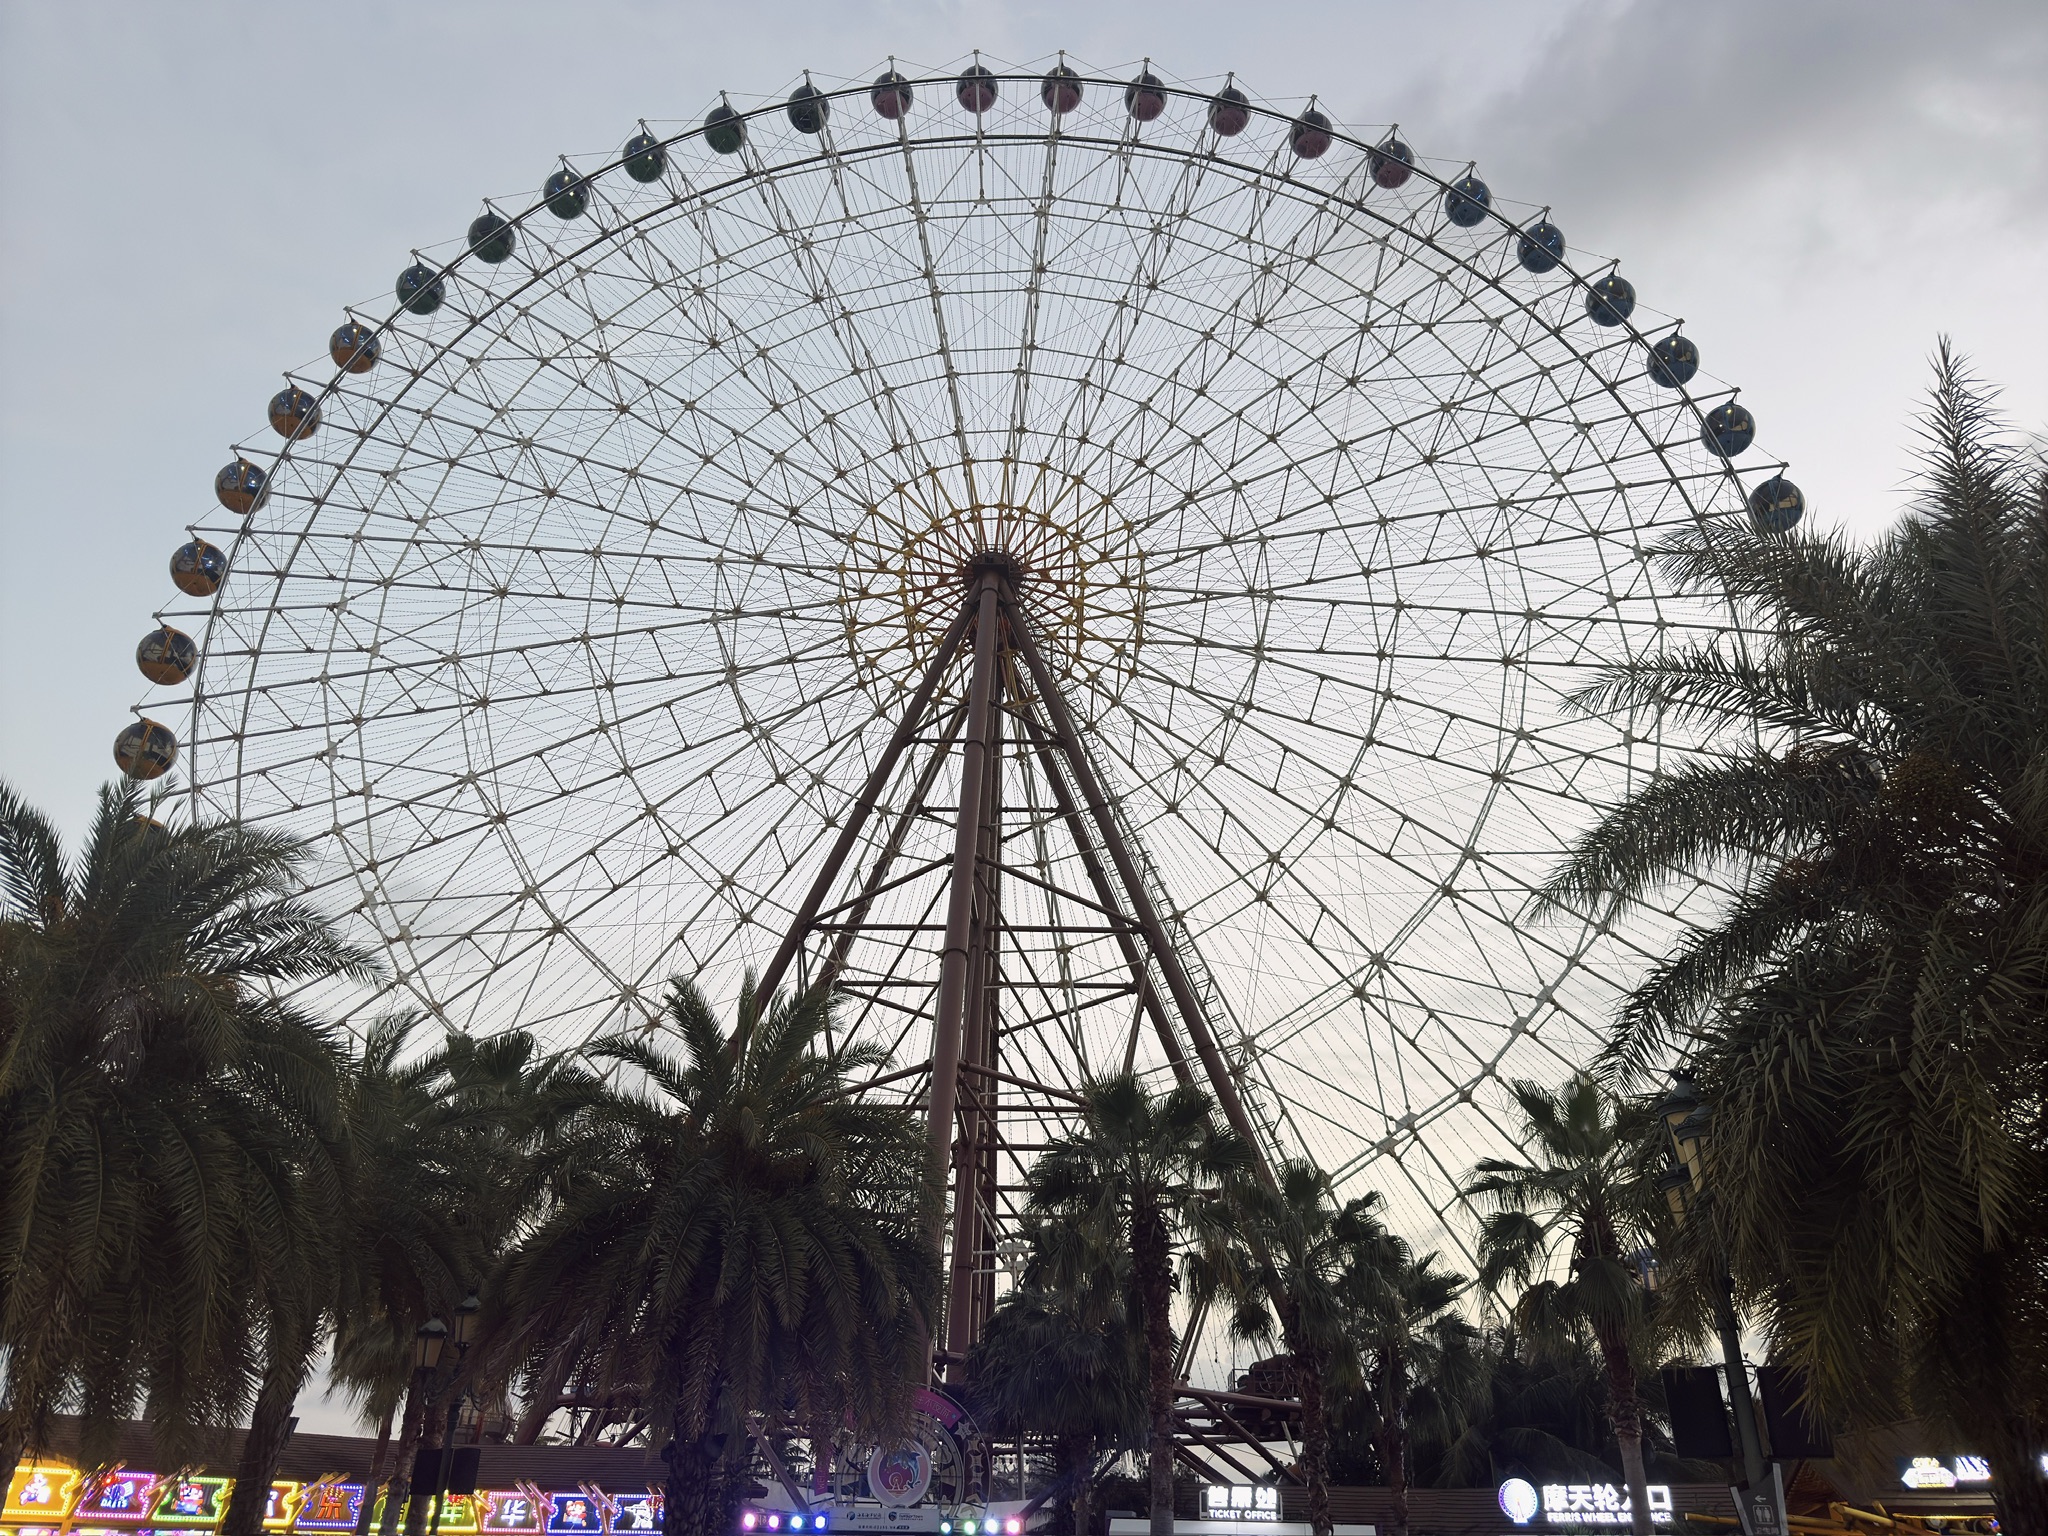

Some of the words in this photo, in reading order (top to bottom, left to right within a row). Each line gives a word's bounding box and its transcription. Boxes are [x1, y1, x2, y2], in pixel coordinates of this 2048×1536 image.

[500, 1498, 526, 1526] 华
[1209, 1509, 1241, 1519] TICKET
[1244, 1510, 1277, 1520] OFFICE
[1547, 1512, 1581, 1522] FERRIS
[1582, 1512, 1617, 1522] WHEEL
[1617, 1512, 1672, 1522] ENNCE
